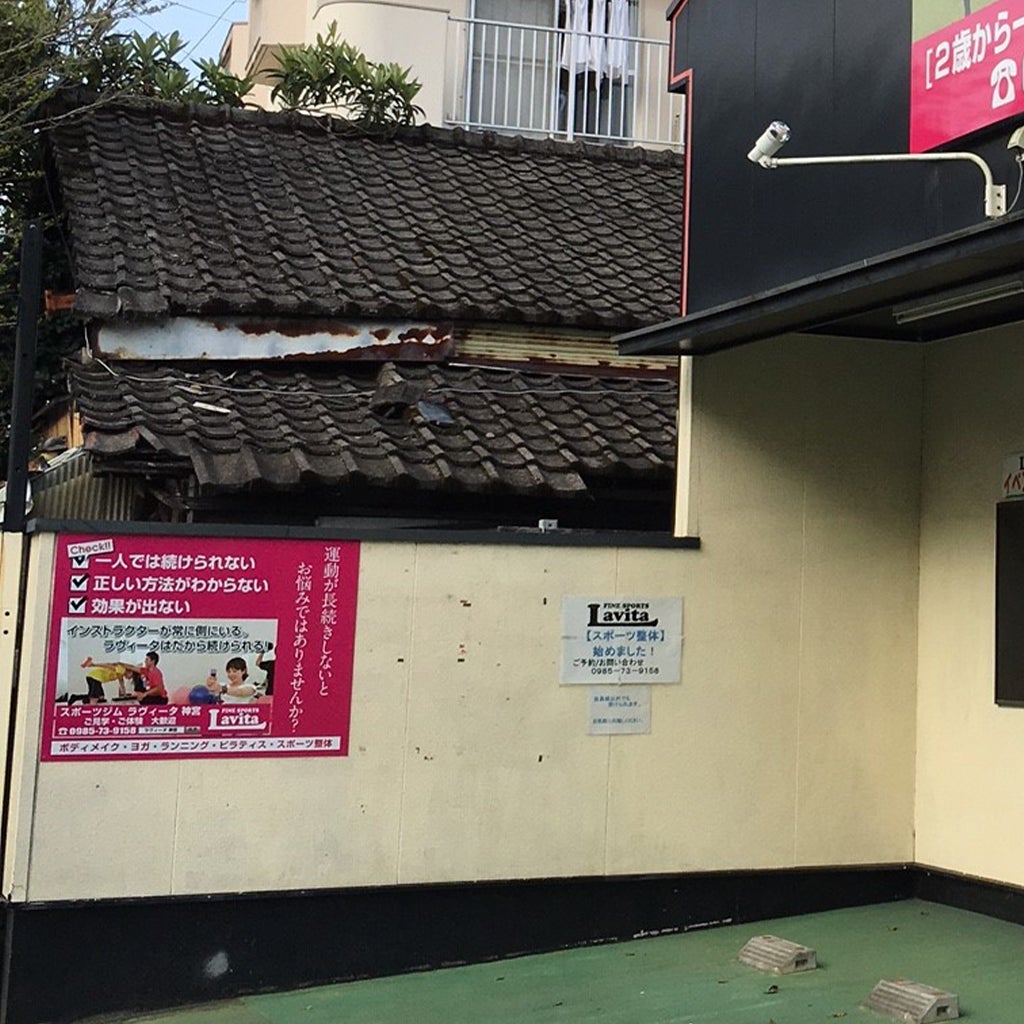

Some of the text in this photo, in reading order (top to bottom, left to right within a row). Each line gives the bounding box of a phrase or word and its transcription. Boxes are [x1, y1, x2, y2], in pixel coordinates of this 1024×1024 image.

[95, 553, 256, 570] 一人では続けられない
[93, 576, 269, 593] 正しい方法がわからない
[91, 598, 191, 615] 効果が出ない
[587, 604, 658, 627] Lavita
[319, 546, 341, 697] 運動が長続きしないと
[208, 709, 267, 730] Lavita
